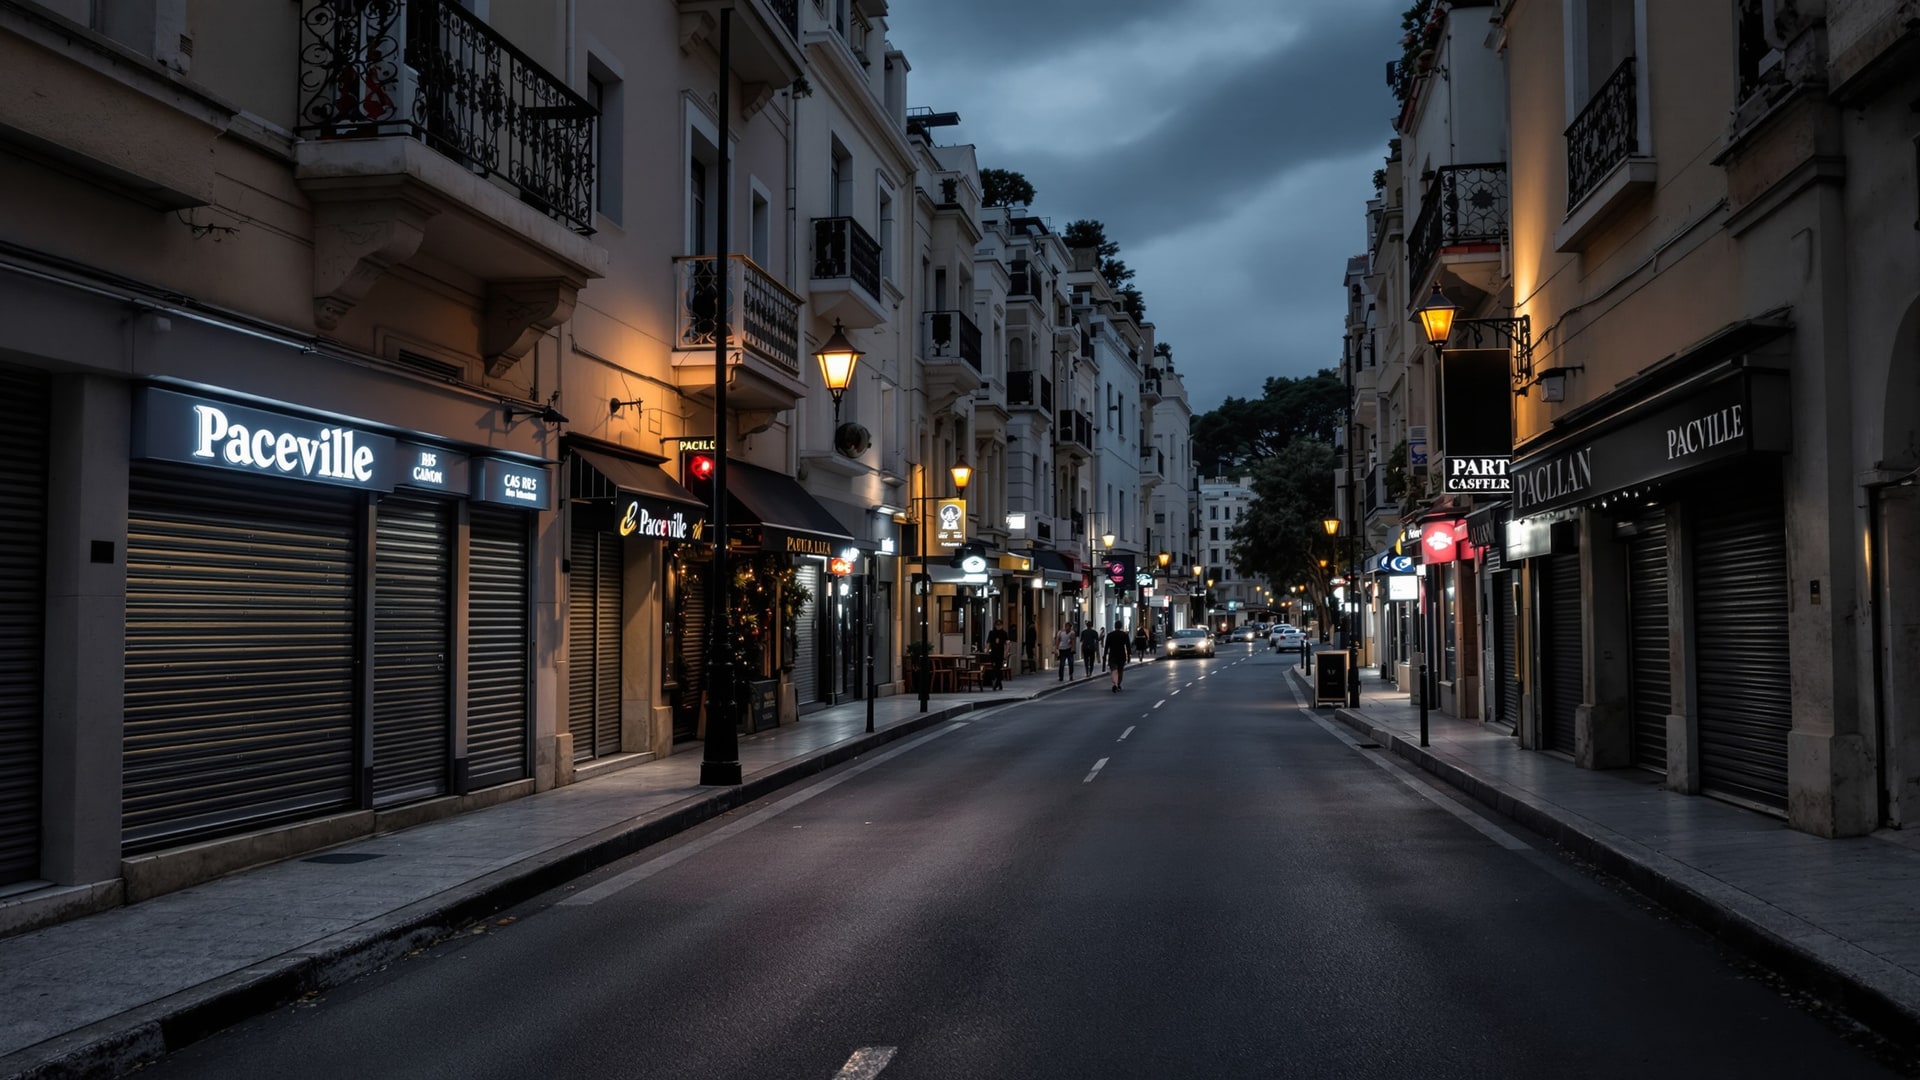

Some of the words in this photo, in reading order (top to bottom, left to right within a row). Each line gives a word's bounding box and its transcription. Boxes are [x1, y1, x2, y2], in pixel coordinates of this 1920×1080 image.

[193, 404, 374, 482] Paceville
[1666, 404, 1744, 460] PACVILLE
[1451, 459, 1511, 476] PART
[1517, 447, 1593, 509] PACLLAN
